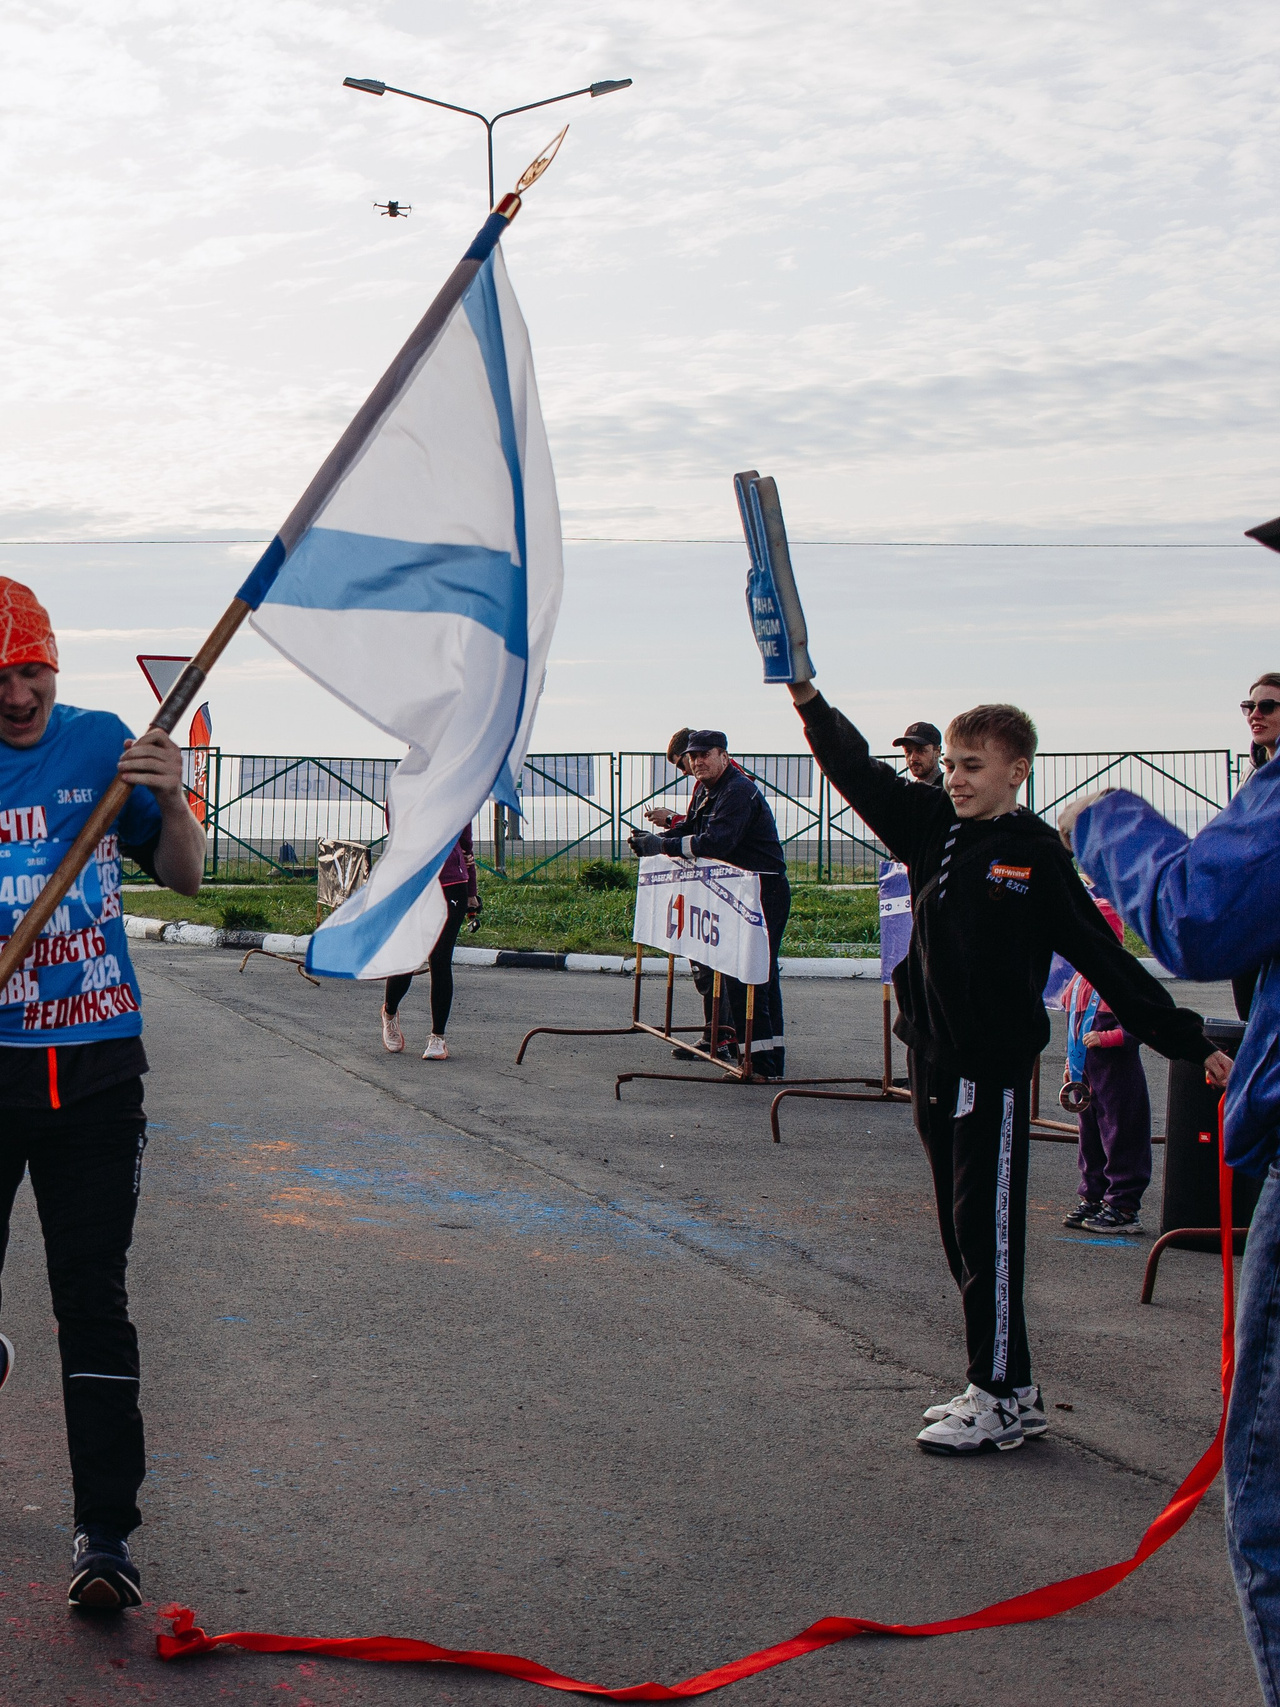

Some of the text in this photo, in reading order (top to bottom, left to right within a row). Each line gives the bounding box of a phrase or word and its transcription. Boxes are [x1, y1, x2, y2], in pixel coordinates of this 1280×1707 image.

[690, 905, 720, 947] ПСБ
[23, 983, 140, 1029] #ЕДИНСТВО
[1000, 1282, 1008, 1302] OPEN
